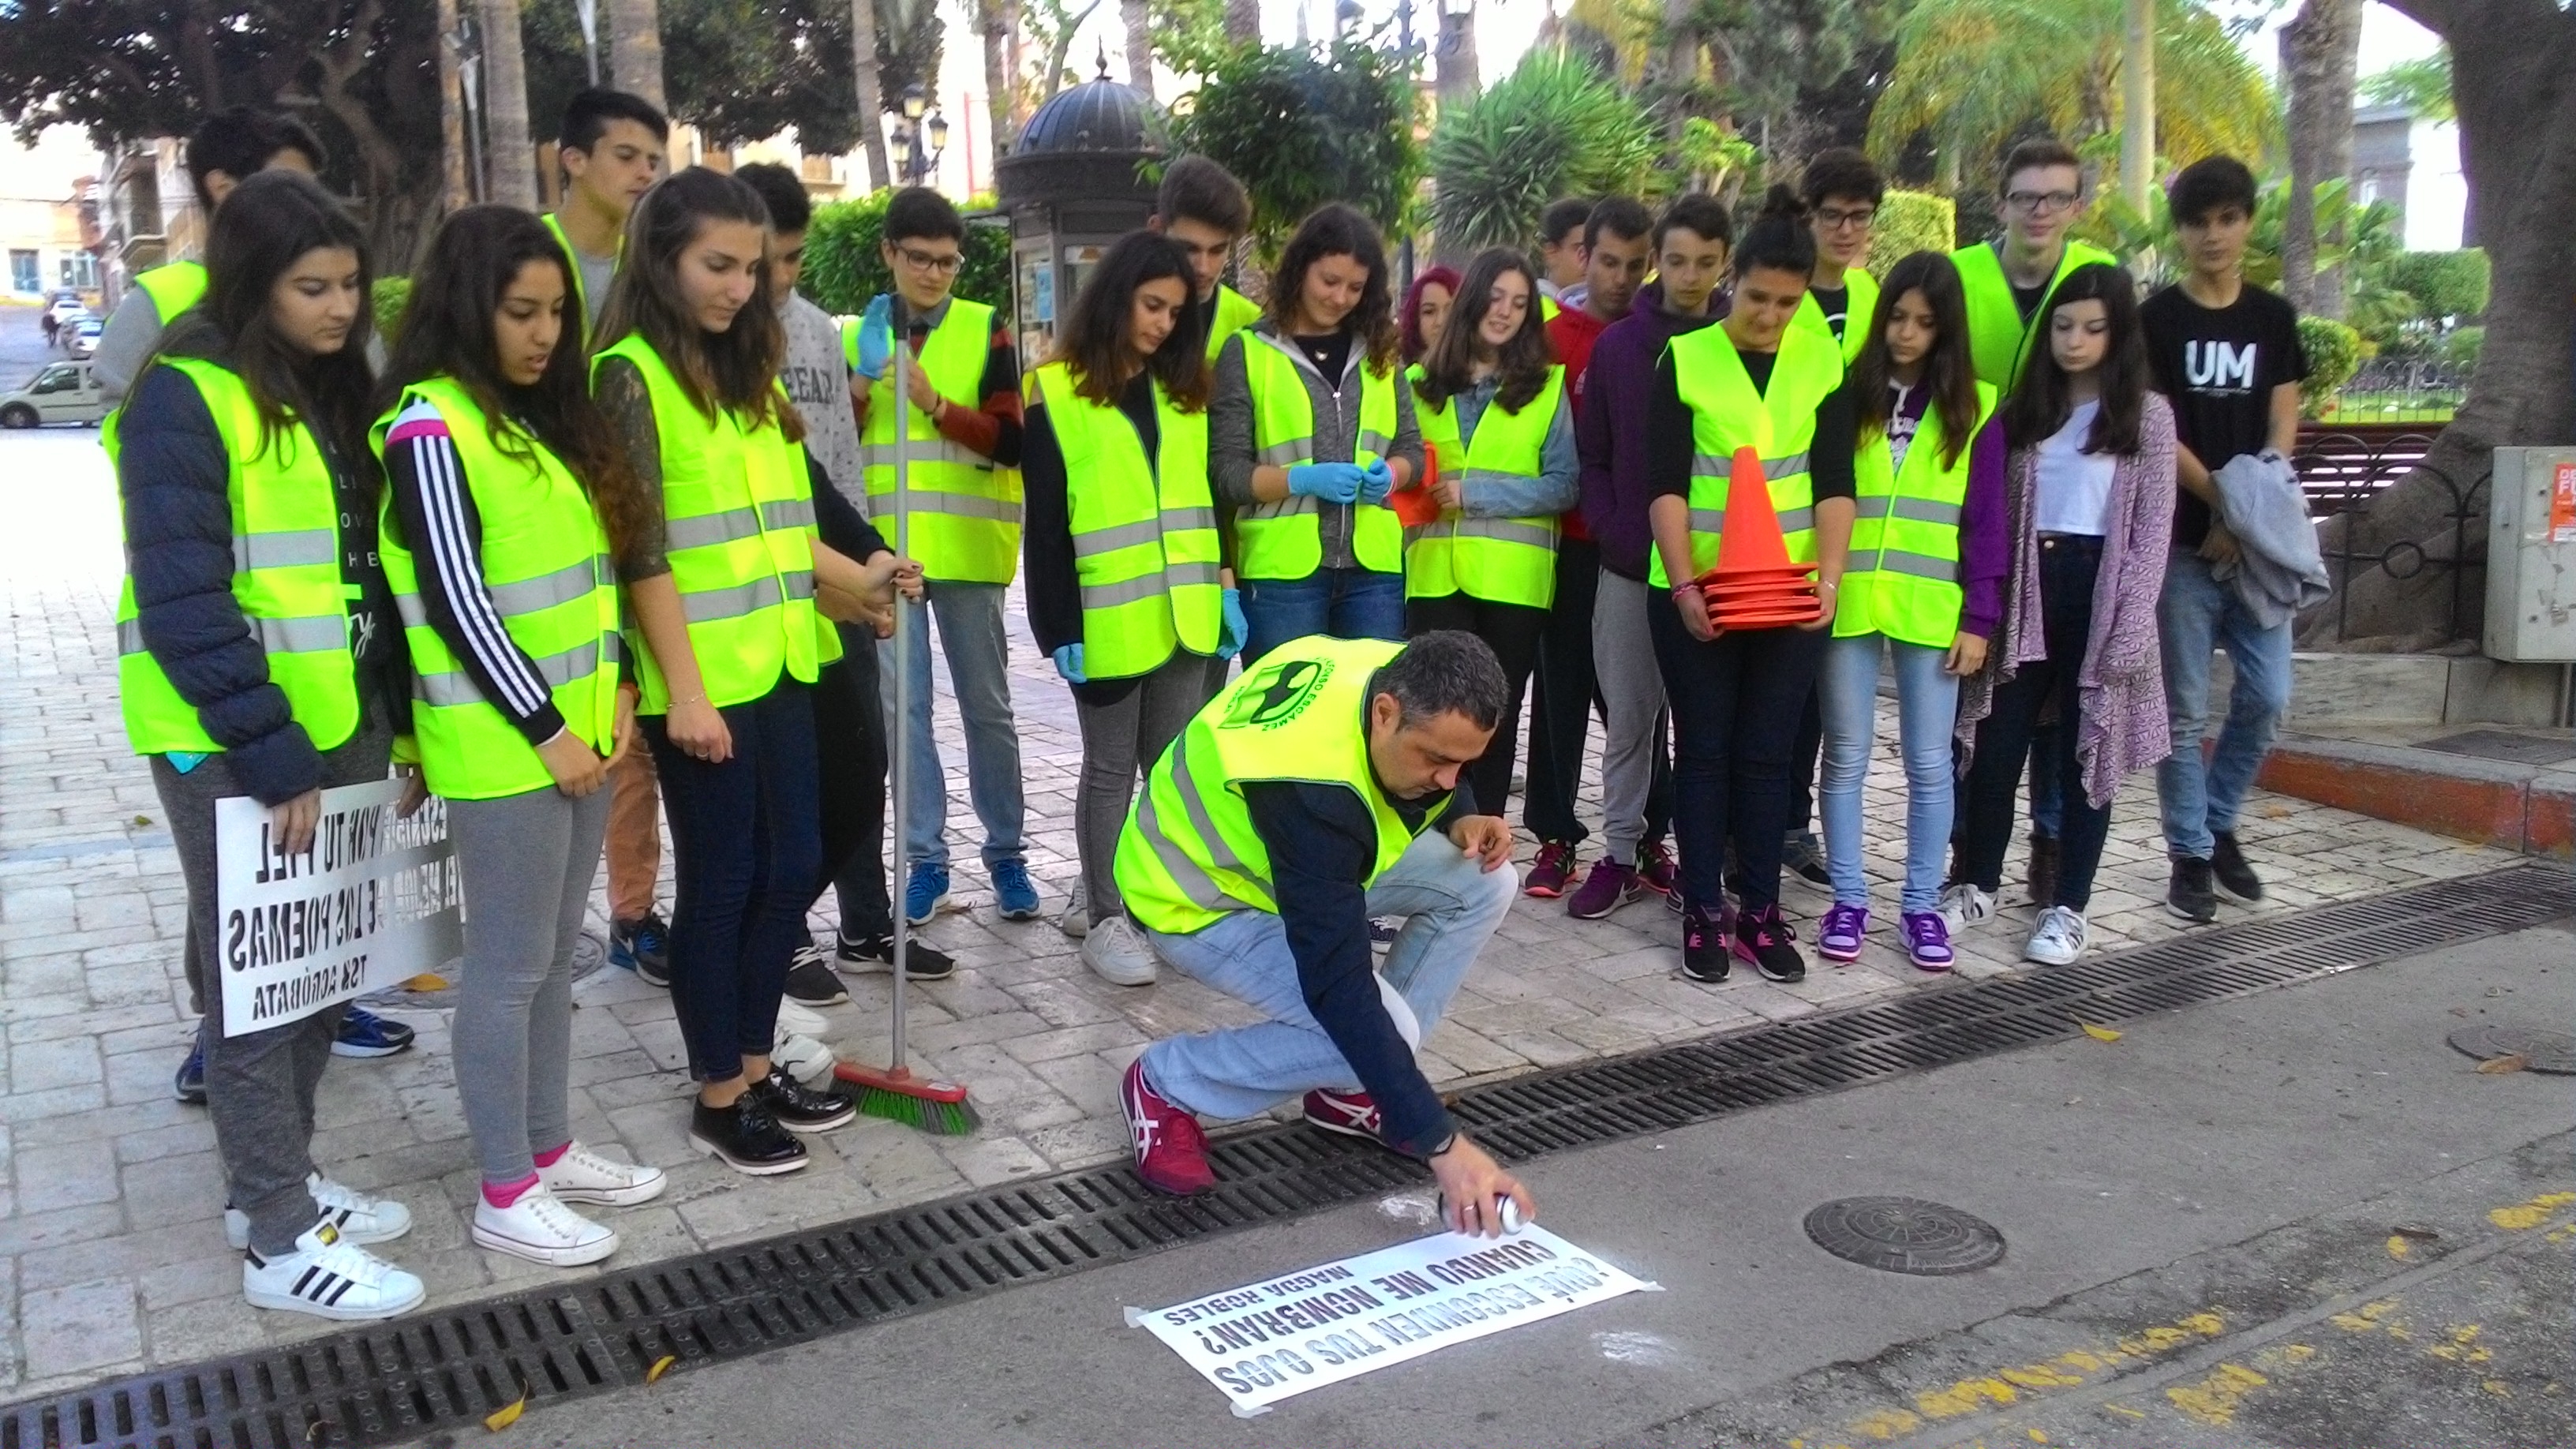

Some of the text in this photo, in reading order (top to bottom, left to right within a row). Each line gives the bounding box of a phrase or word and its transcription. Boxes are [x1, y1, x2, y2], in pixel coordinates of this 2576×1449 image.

[2185, 339, 2257, 388] UM
[1163, 1265, 1354, 1326] MAGDA ROBLES
[1193, 1240, 1558, 1355] CUANDO ME NOMBRAN?
[1214, 1257, 1609, 1394] ¿QUÉ ESCONDEN TUS OJOS
